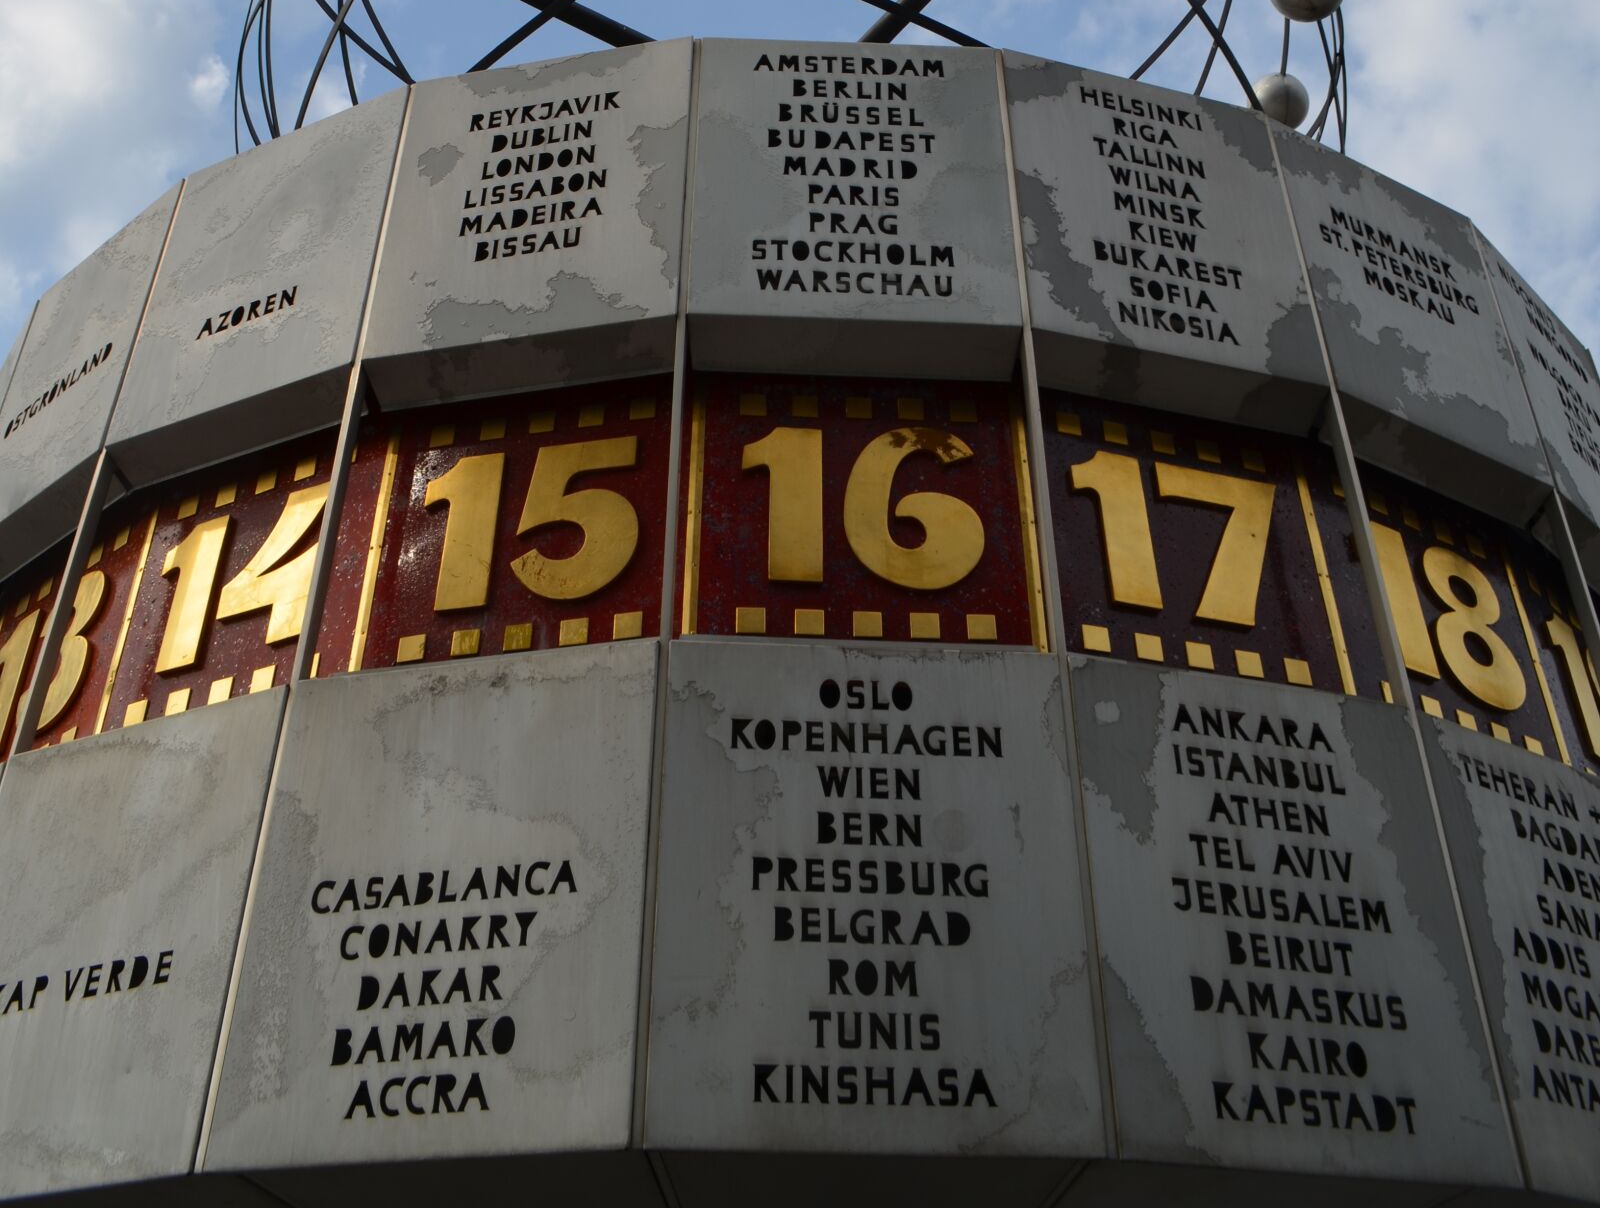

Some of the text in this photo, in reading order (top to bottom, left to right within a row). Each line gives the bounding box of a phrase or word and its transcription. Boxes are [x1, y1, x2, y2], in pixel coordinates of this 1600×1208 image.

[753, 54, 945, 78] AMSTERDAM
[468, 91, 621, 133] REYKJAVIK
[793, 79, 907, 101] BERLIN
[1080, 87, 1202, 131] HELSINKI
[779, 103, 924, 126] BRÜSSEL
[1113, 118, 1177, 149] RIGA
[491, 121, 592, 153] DUBLIN
[767, 128, 936, 153] BUDAPEST
[1093, 137, 1206, 179] TALLINN
[480, 145, 595, 180] LONDON
[783, 156, 918, 180] MADRID
[1108, 165, 1201, 203] WILNA
[463, 169, 607, 209] LISSABON
[807, 184, 899, 206] PARIS
[1114, 192, 1206, 229] MINSK
[458, 197, 602, 237] MADEIRA
[809, 212, 898, 235] PRAG
[1129, 221, 1197, 254] KIEW
[473, 227, 581, 263] BISSAU
[751, 240, 955, 268] STOCKHOLM
[1093, 241, 1242, 290] BUKAREST
[1330, 206, 1457, 282] MURMANSK
[756, 269, 953, 297] WARSCHAU
[1130, 276, 1217, 313] SOFIA
[1363, 266, 1455, 325] MOSKAU
[195, 286, 298, 341] AZOREN
[1118, 301, 1240, 346] NIKOSIA
[4, 342, 112, 440] OSTGRÖNLAND
[424, 435, 639, 611] 15
[742, 427, 985, 589] 16
[1071, 450, 1277, 626] 17
[154, 481, 329, 674] 14
[1368, 520, 1526, 711] 18
[819, 679, 913, 711] OSLO
[1546, 613, 1600, 758] 1
[730, 718, 1003, 758] KOPENHAGEN
[1173, 703, 1334, 753] ANKARA
[817, 766, 920, 800] WIEN
[1172, 745, 1346, 795] ISTANBUL
[1457, 753, 1579, 822] TEHERAN
[816, 811, 922, 847] BERN
[1208, 793, 1330, 836] ATHEN
[1510, 808, 1600, 865] BAGDA
[752, 857, 989, 898] PRESSBURG
[1189, 834, 1352, 883] TEL AVIV
[311, 860, 578, 914] CASABLANCA
[1172, 878, 1392, 933] JERUSALEM
[340, 912, 538, 961] CONAKRY
[773, 906, 971, 946] BELGRAD
[1226, 930, 1352, 976] BEIRUT
[1513, 927, 1591, 979] ADDIS
[0, 950, 173, 1014] AP VERDE
[356, 964, 502, 1011] DAKAR
[828, 959, 918, 998] ROM
[1521, 971, 1600, 1023] MOGA
[1190, 976, 1407, 1031] DAMASKUS
[331, 1016, 515, 1067] BAMAKO
[809, 1011, 940, 1051] TUNIS
[1247, 1032, 1368, 1078] KAIRO
[344, 1073, 490, 1120] ACCRA
[753, 1064, 998, 1108] KINSHASA
[1212, 1082, 1416, 1135] KAPSTADT
